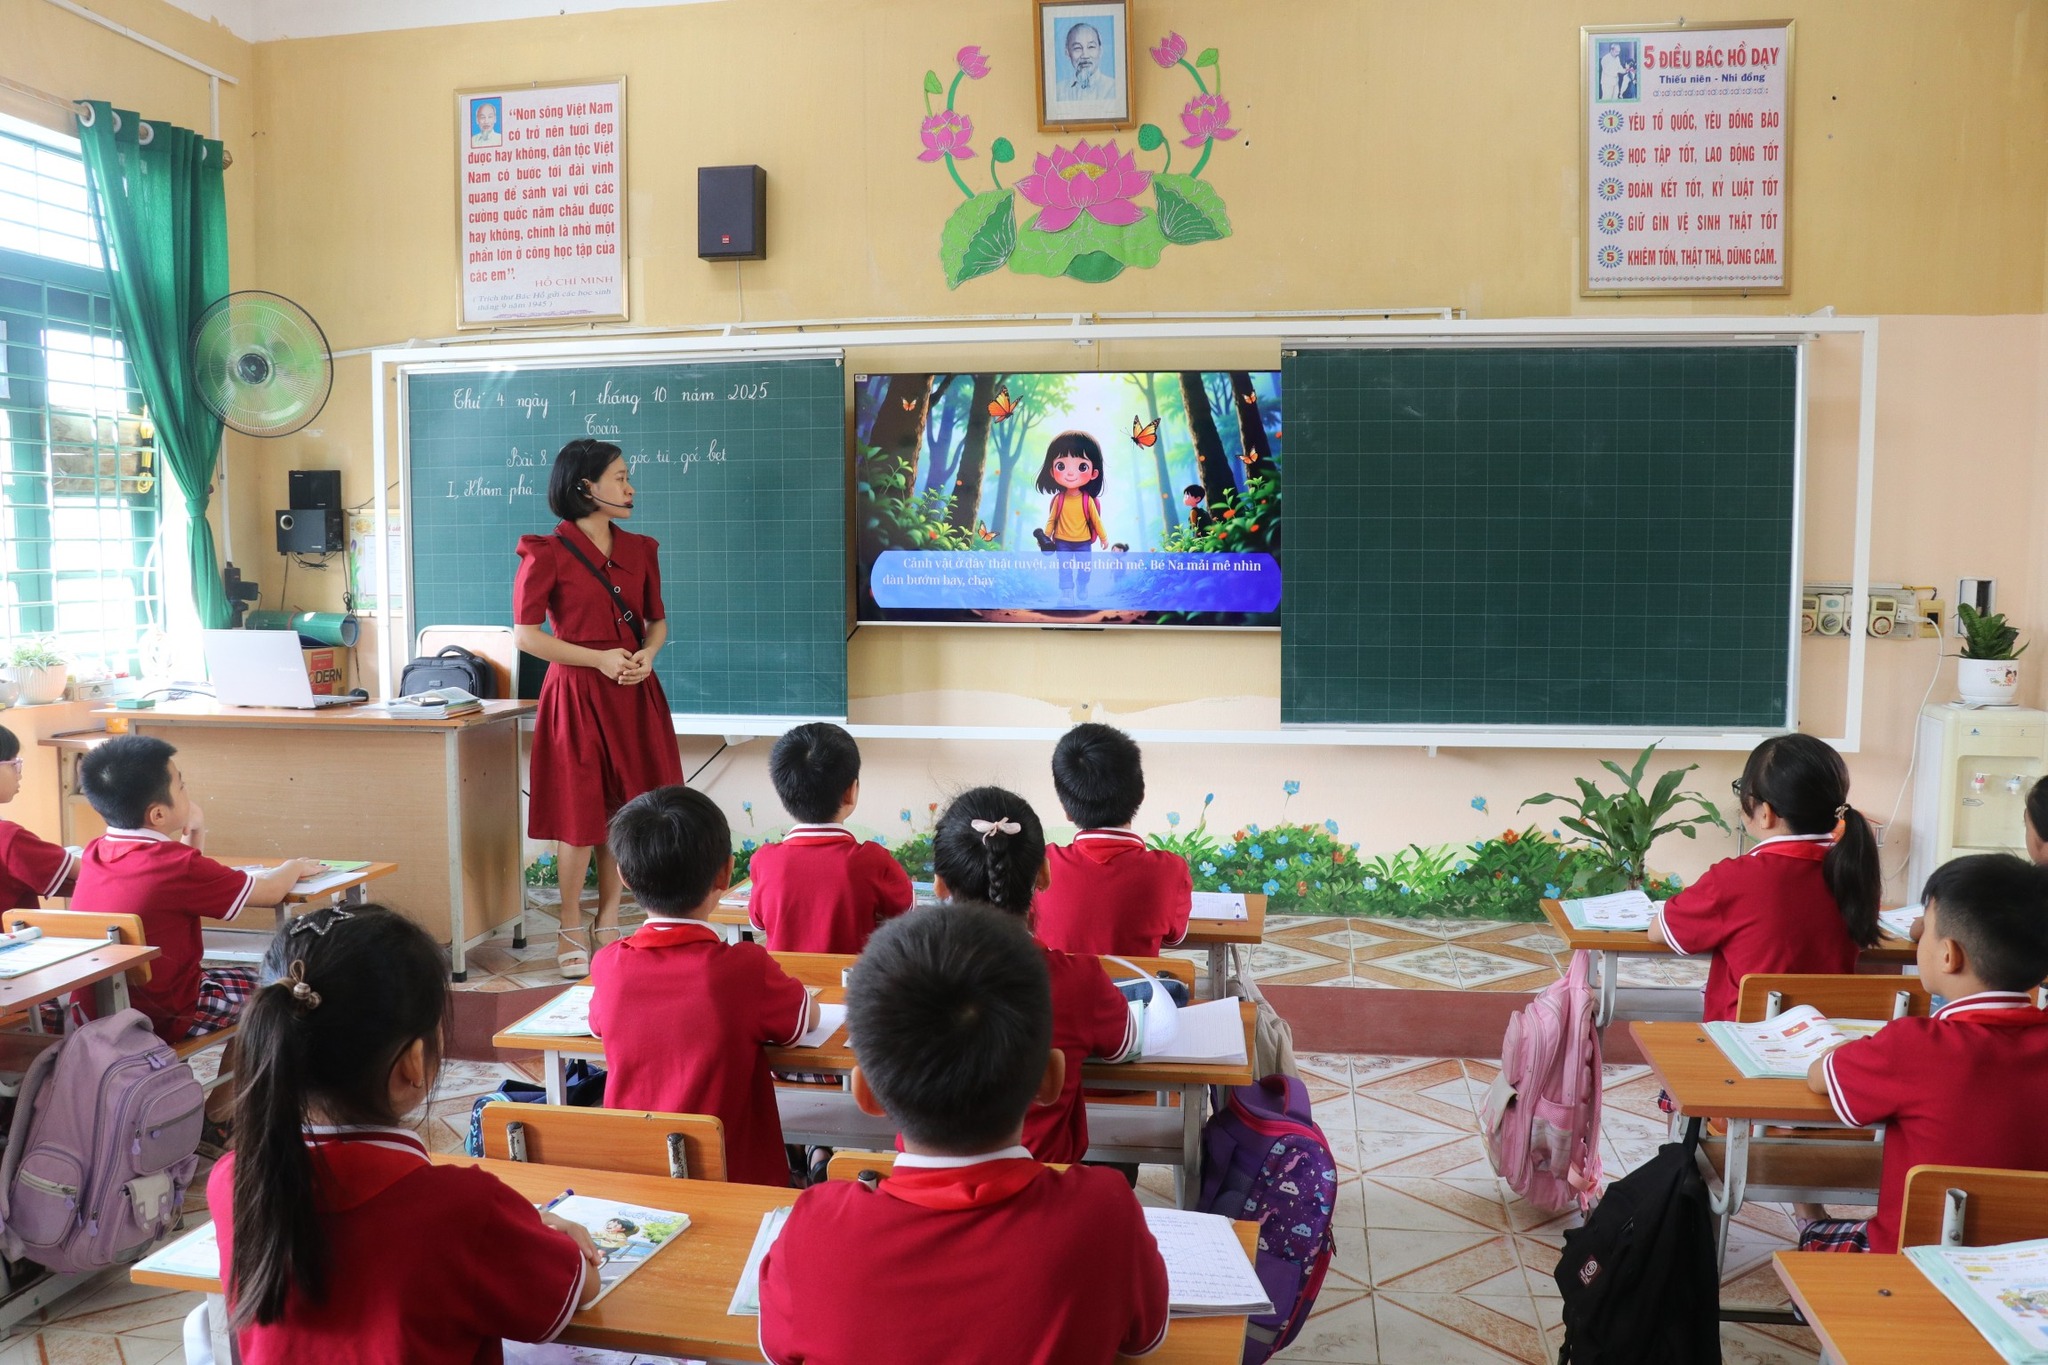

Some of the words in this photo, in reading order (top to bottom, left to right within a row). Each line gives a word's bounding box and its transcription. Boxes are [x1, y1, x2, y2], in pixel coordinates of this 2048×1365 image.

[1644, 45, 1654, 69] 5
[1659, 42, 1691, 68] ĐIỀU
[1696, 44, 1724, 68] BÁC
[1728, 41, 1746, 66] HỒ
[1751, 46, 1779, 69] DẠY
[1659, 74, 1686, 84] Thiếu
[1690, 74, 1711, 83] niên
[1722, 73, 1737, 82] Nhi
[539, 105, 563, 118] sông
[567, 103, 586, 118] Việt
[590, 102, 612, 114] Nam
[1629, 113, 1645, 131] YÊU
[1671, 108, 1697, 132] QUỐC,
[1705, 112, 1721, 129] YÊU
[509, 129, 520, 141] có
[546, 126, 564, 137] nên
[570, 123, 589, 136] tươi
[595, 122, 613, 136] đẹp
[495, 150, 512, 162] hay
[553, 145, 571, 157] dân
[575, 143, 590, 158] tộc
[594, 141, 613, 156] Việt
[1629, 148, 1646, 167] HỌC
[1655, 144, 1670, 166] TẬP
[1679, 141, 1697, 165] TỐT,
[1705, 147, 1722, 162] LAO
[1730, 143, 1755, 165] ĐỘNG
[1763, 139, 1779, 161] TỐT
[468, 171, 490, 183] Nam
[498, 169, 509, 181] có
[549, 165, 561, 177] tới
[593, 162, 613, 174] vinh
[469, 191, 498, 204] quang
[523, 186, 546, 199] sánh
[553, 185, 567, 197] vai
[574, 183, 589, 195] với
[595, 182, 613, 194] các
[1661, 176, 1677, 197] KẾT
[1686, 176, 1704, 198] TỐT,
[1732, 178, 1754, 199] LUẬT
[1762, 175, 1778, 196] TỐT
[469, 208, 498, 223] cường
[504, 205, 527, 222] quốc
[533, 206, 554, 218] năm
[560, 204, 584, 216] châu
[589, 202, 614, 217] được
[1678, 212, 1688, 234] VỆ
[1698, 214, 1720, 230] SINH
[1729, 211, 1752, 233] THẬT
[1761, 208, 1777, 229] TỐT
[469, 231, 486, 243] hay
[527, 226, 555, 238] chính
[559, 224, 568, 236] là
[573, 222, 591, 235] nhờ
[595, 222, 614, 236] một
[470, 247, 493, 264] phần
[497, 249, 512, 260] lớn
[526, 246, 550, 259] công
[554, 245, 572, 259] học
[576, 243, 592, 258] tập
[596, 240, 614, 254] của
[1628, 247, 1656, 265] KHIÊM
[1659, 244, 1678, 266] TỐN,
[1681, 247, 1702, 268] THẬT
[1754, 242, 1776, 264] CẢM.
[470, 270, 487, 282] các
[535, 276, 552, 287] HỒ
[556, 275, 576, 285] CHÍ
[581, 276, 613, 284] MINH
[454, 388, 486, 409] Thứ
[497, 393, 504, 406] 4
[518, 393, 548, 419] ngày
[570, 390, 576, 405] 1
[596, 381, 641, 415] tháng
[651, 386, 666, 402] 10
[728, 382, 769, 400] 2025
[584, 413, 620, 435] Toán
[506, 447, 534, 467] Bài
[540, 450, 547, 466] 8
[630, 449, 650, 475] góc
[680, 446, 700, 474] góc
[707, 439, 727, 465] bẹt
[464, 477, 502, 496] Khám
[904, 558, 932, 569] Cảnh
[935, 558, 952, 570] vật
[989, 558, 1011, 570] thật
[1049, 559, 1059, 569] ai
[1062, 557, 1091, 572] cũng
[1094, 559, 1123, 570] thích
[1151, 559, 1165, 570] Bé
[1168, 560, 1184, 570] Na
[1212, 560, 1230, 571] mê
[1234, 559, 1261, 572] nhìn
[943, 575, 965, 587] bay,
[309, 668, 342, 684] ODERN
